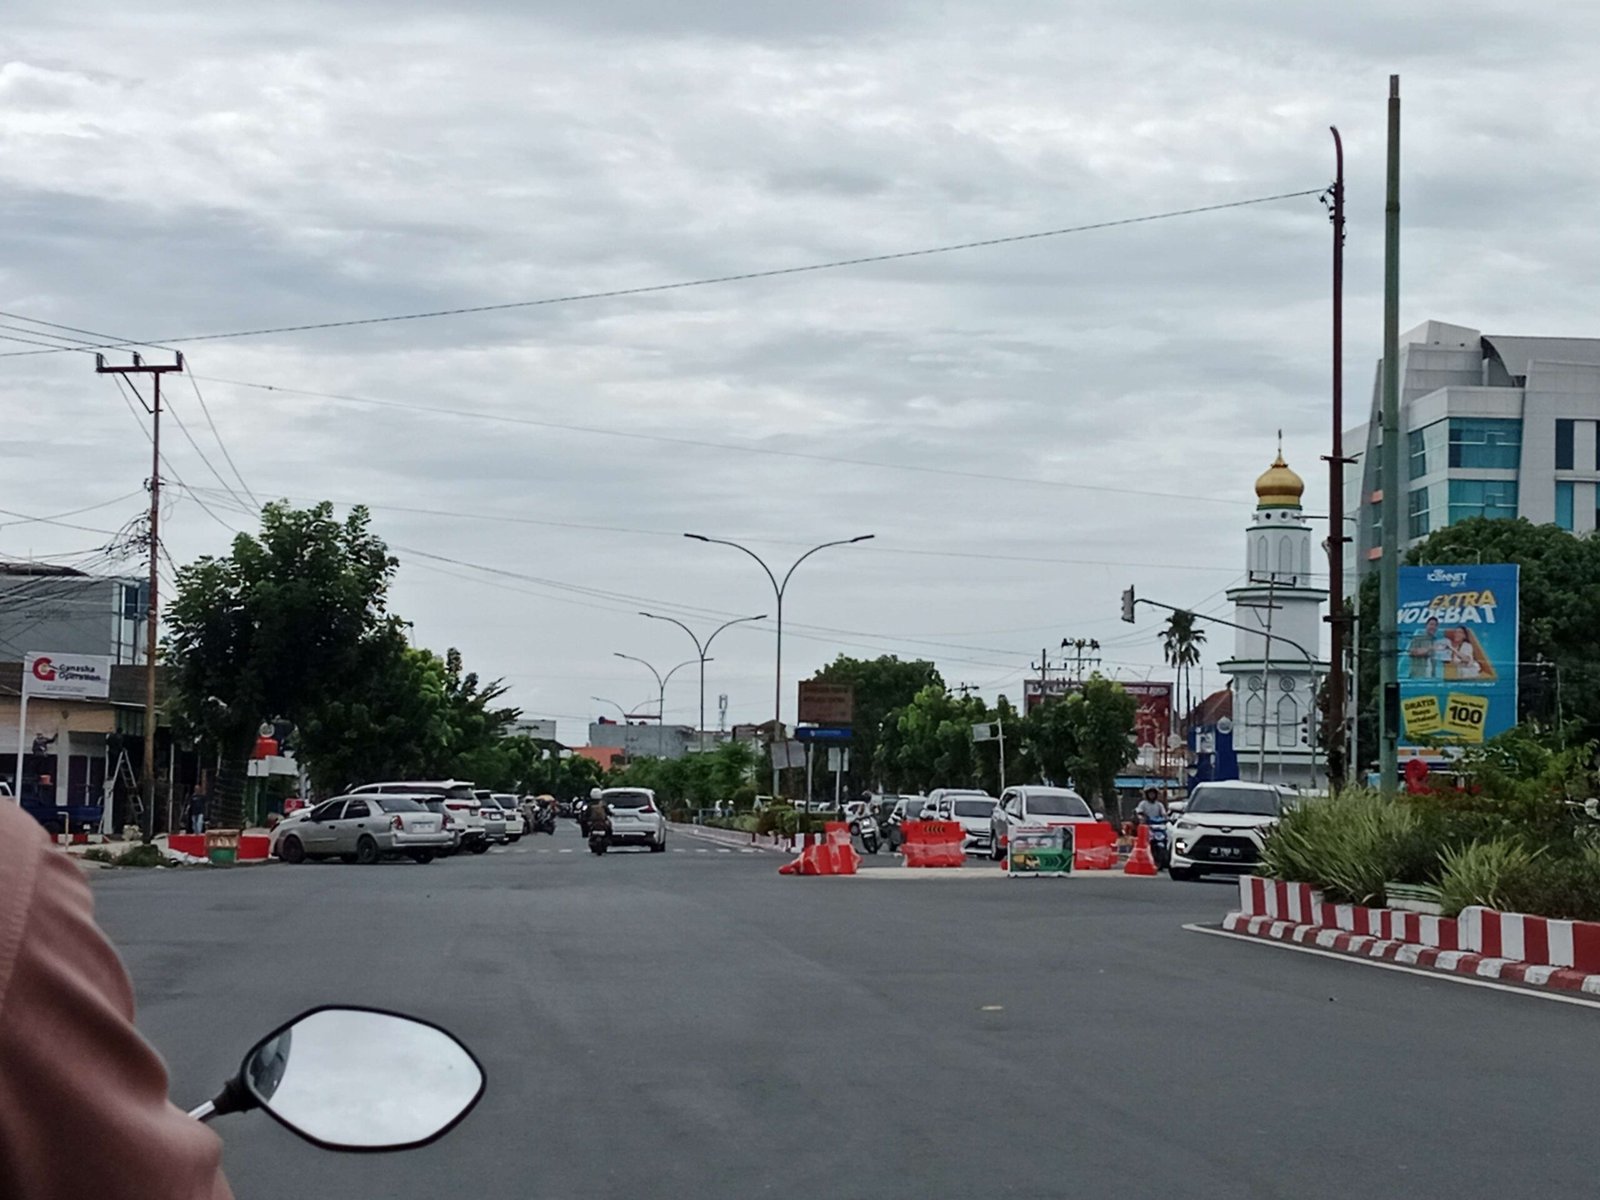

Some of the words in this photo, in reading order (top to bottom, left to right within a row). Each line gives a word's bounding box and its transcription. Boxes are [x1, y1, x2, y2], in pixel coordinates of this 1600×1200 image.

[1429, 590, 1496, 609] EXTRA
[1404, 698, 1436, 711] GRATIS
[1449, 705, 1483, 724] 100
